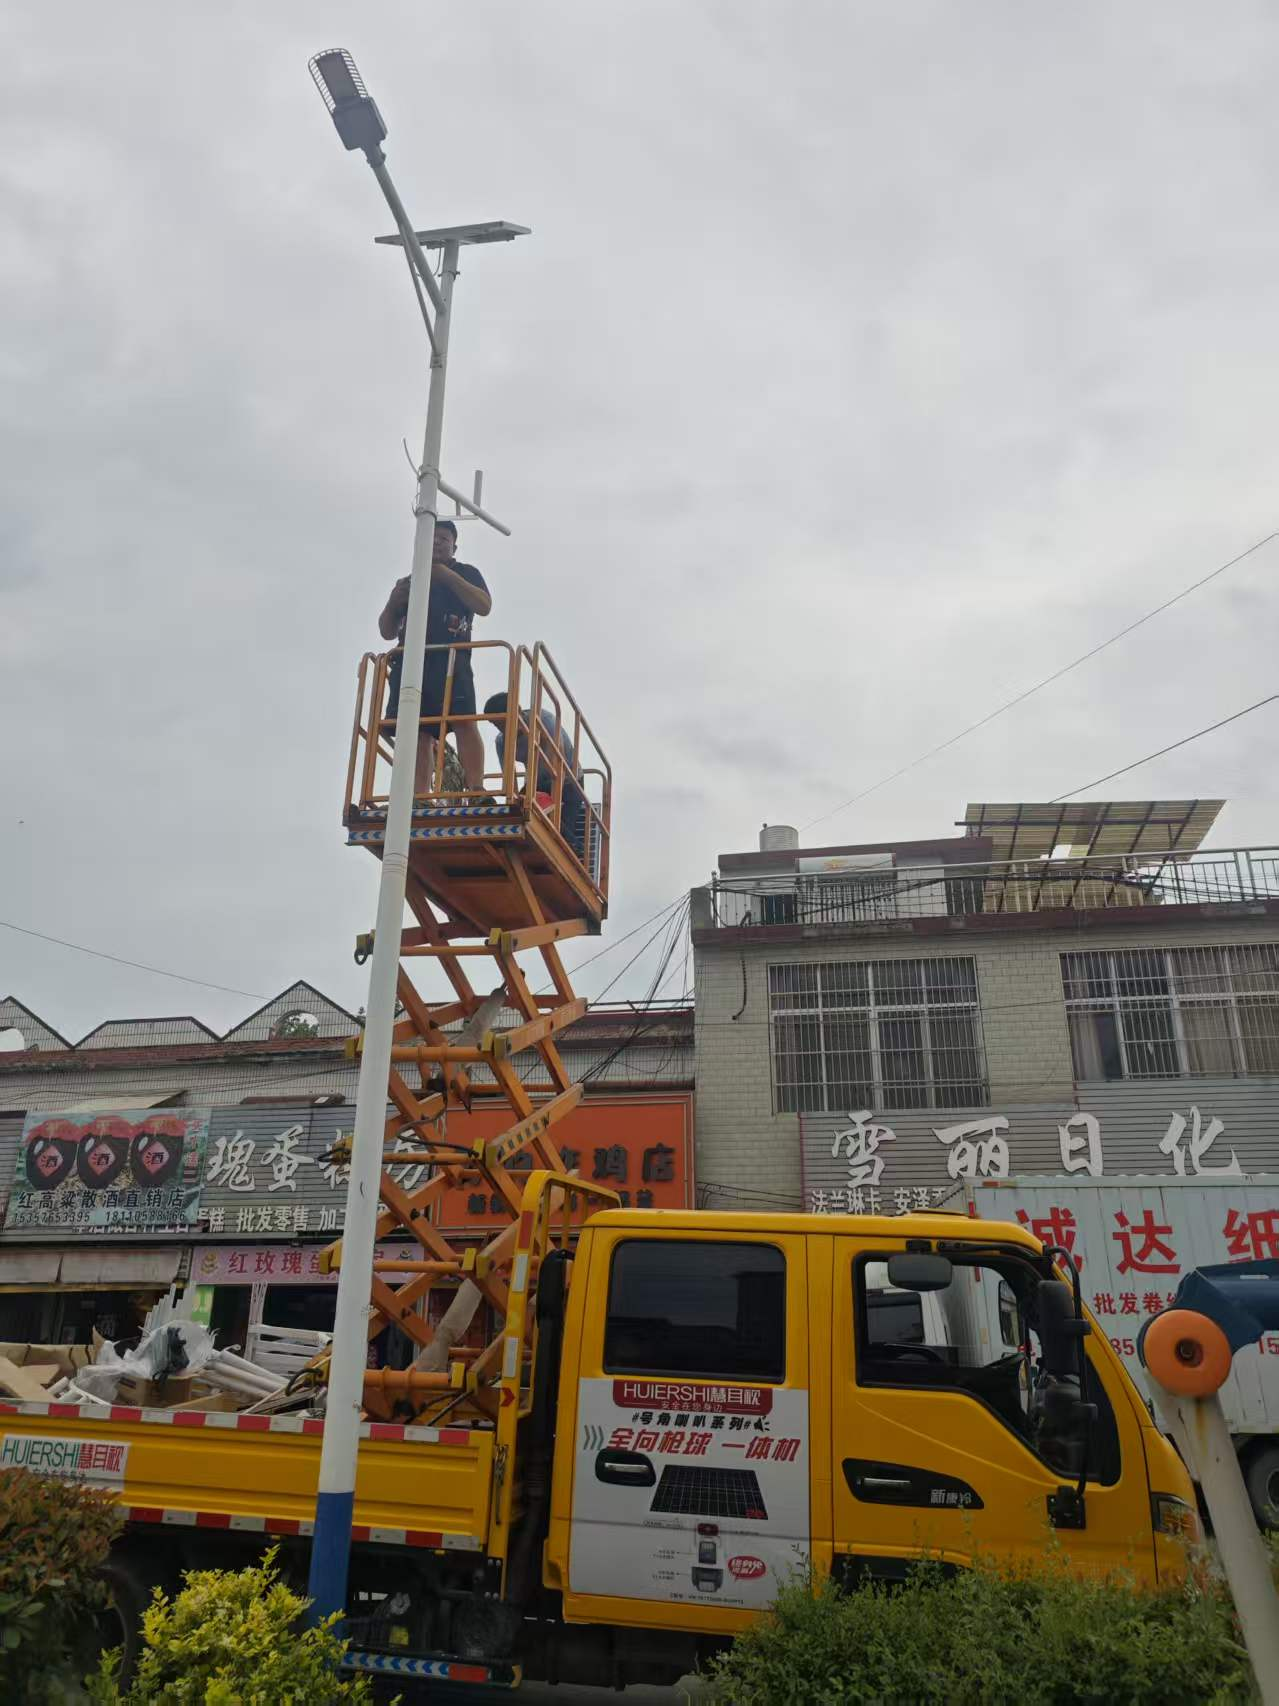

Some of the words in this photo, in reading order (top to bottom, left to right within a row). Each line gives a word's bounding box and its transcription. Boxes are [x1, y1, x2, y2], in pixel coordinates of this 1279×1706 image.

[92, 1153, 110, 1166] 酒
[145, 1152, 165, 1165] 酒
[831, 1105, 1242, 1188] 雪丽日化
[41, 1155, 59, 1168] 酒
[811, 1187, 882, 1216] 法兰琳卡
[236, 1206, 310, 1232] 批发零售
[722, 1435, 801, 1462] 一体机
